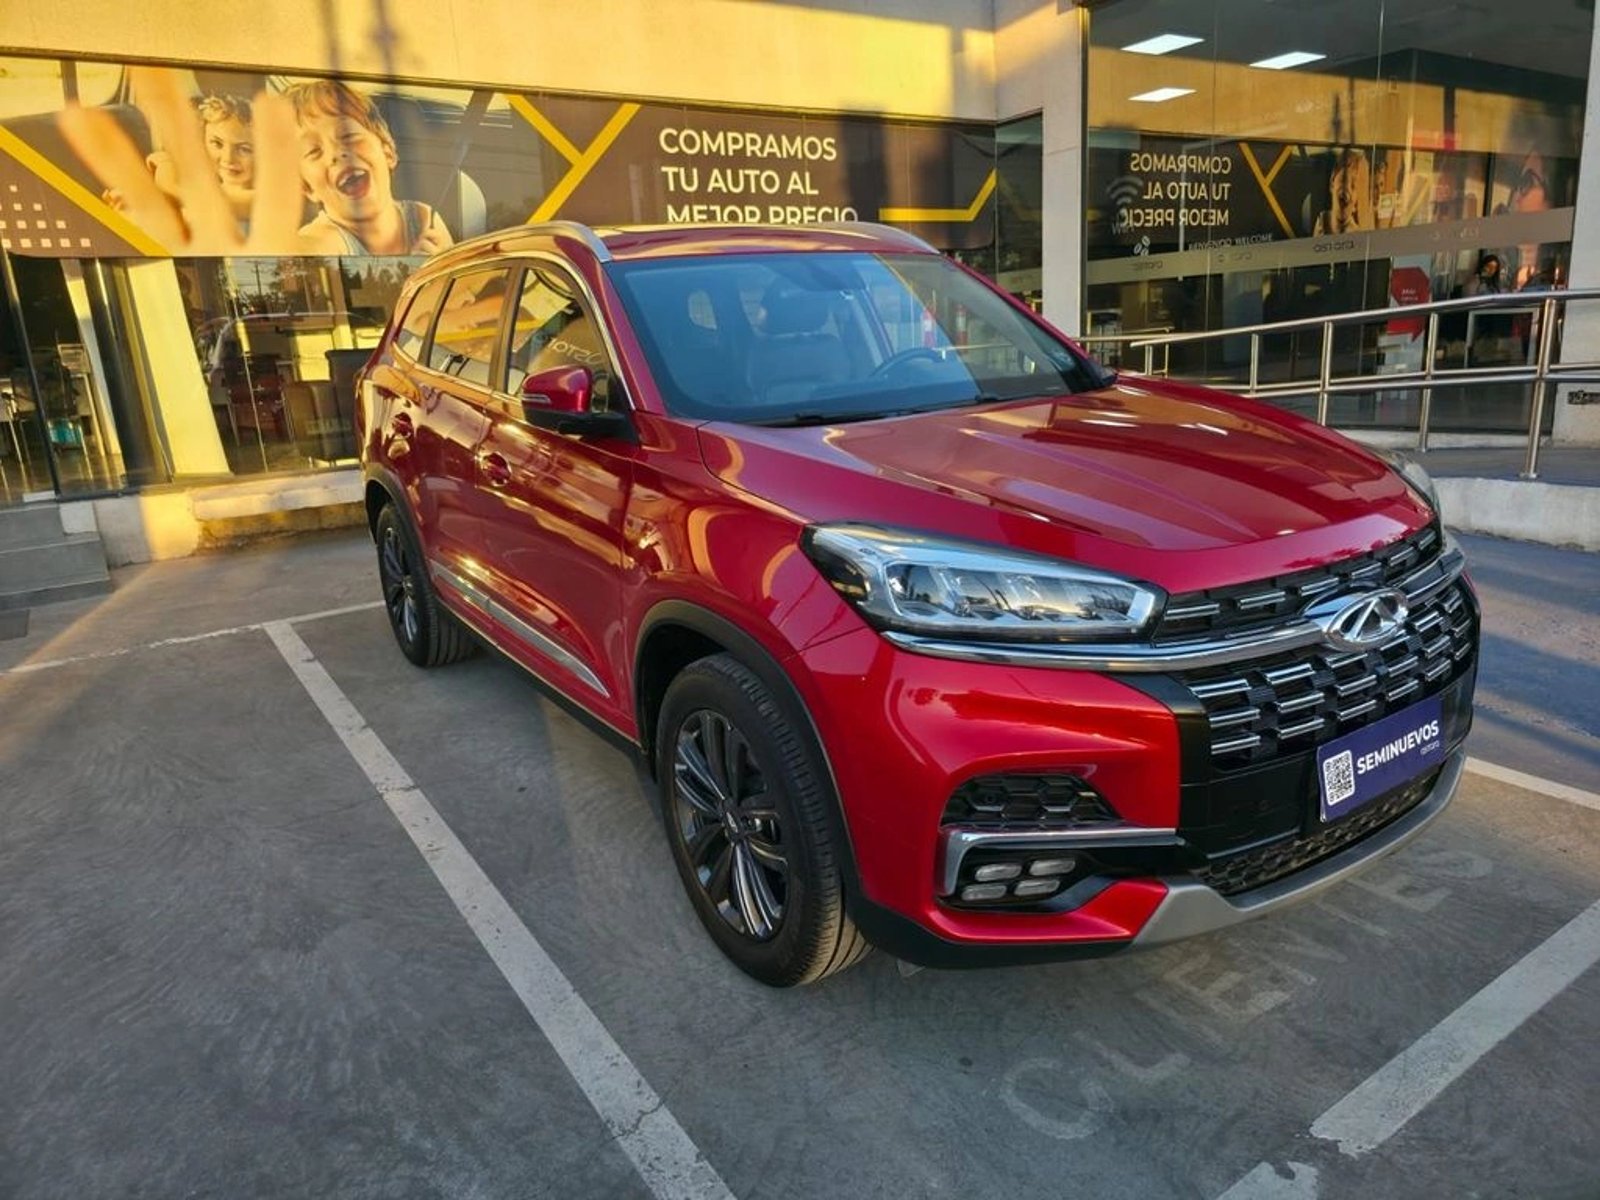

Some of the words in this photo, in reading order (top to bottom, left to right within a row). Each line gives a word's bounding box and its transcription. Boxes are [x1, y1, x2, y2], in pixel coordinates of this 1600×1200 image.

[659, 128, 837, 161] COMPRAMOS
[661, 166, 698, 193] TU
[707, 169, 780, 194] AUTO
[786, 172, 818, 195] AL
[667, 205, 761, 223] MEJOR
[769, 206, 857, 223] PRECIO
[1356, 720, 1439, 774] SEMINUEVOS
